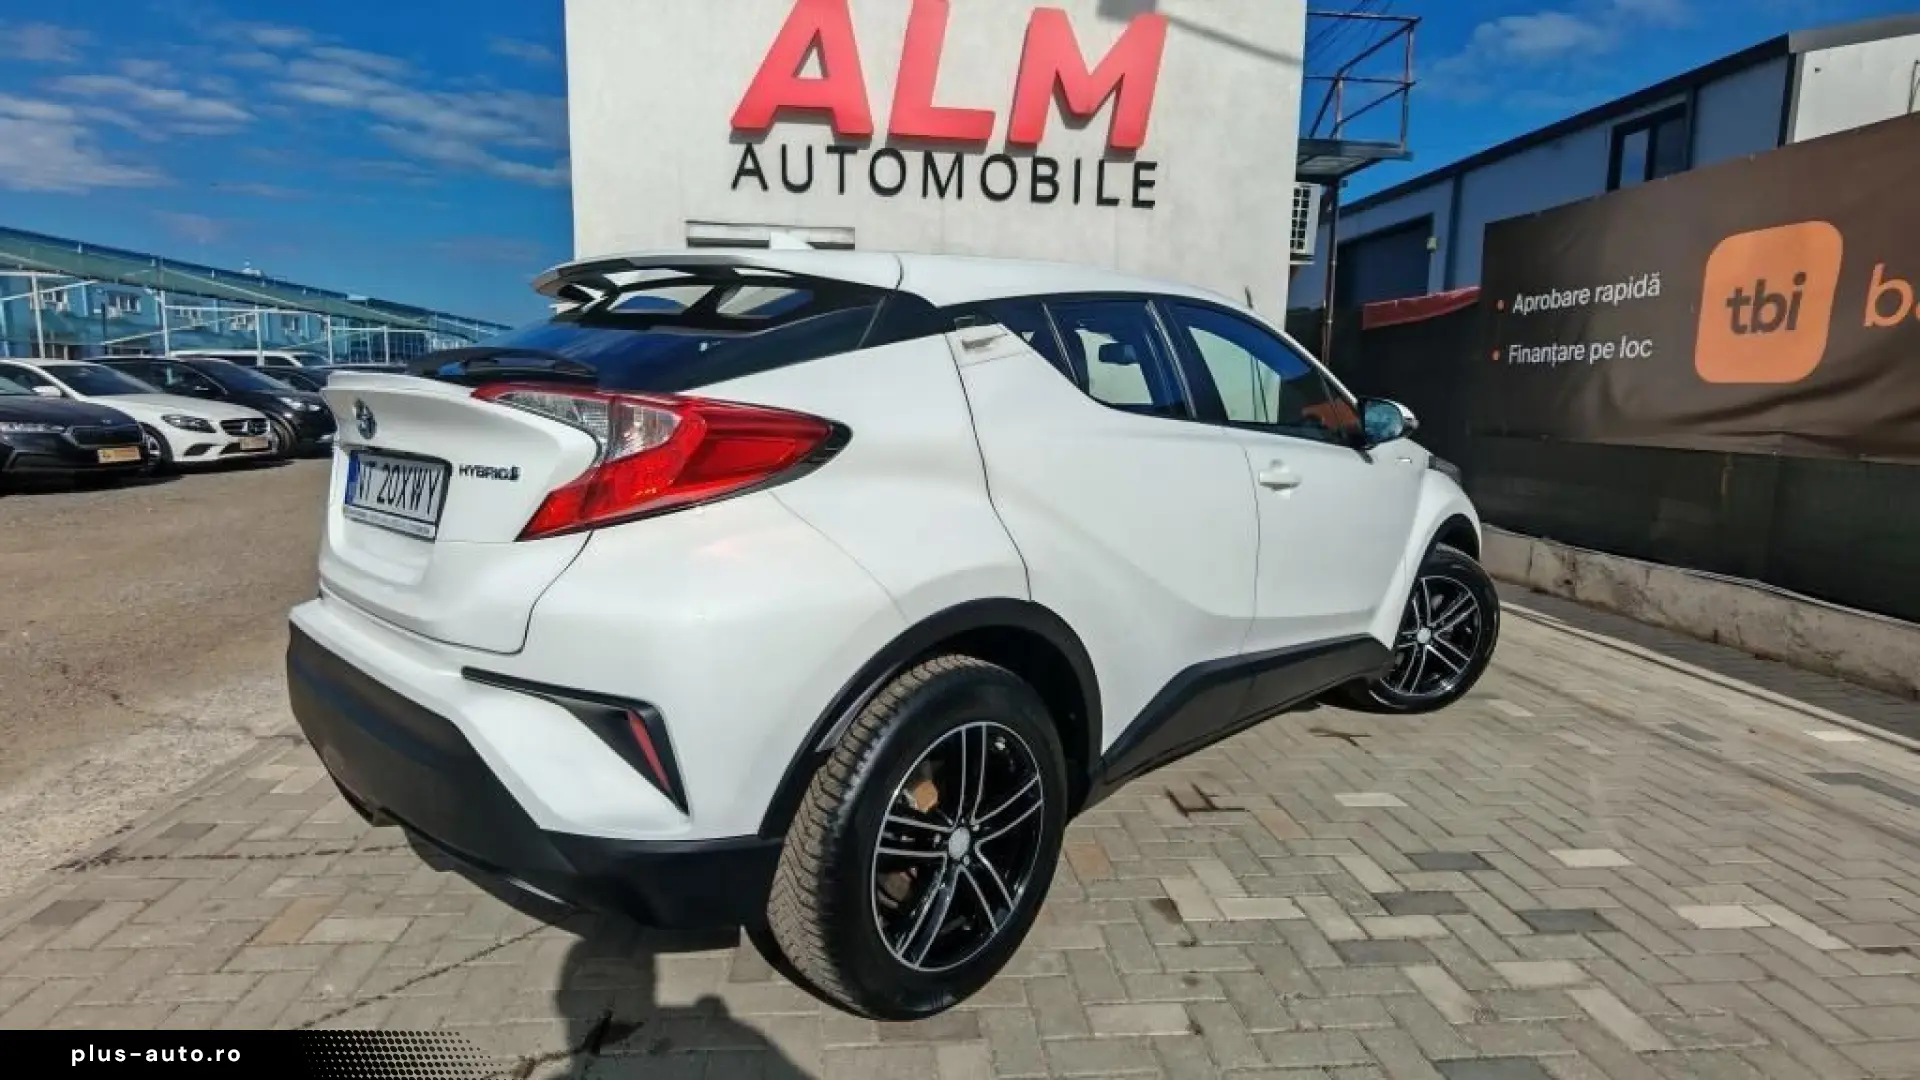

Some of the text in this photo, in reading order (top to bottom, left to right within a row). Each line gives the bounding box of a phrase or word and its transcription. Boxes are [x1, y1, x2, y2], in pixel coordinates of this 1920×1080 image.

[731, 0, 1168, 150] ALM
[731, 143, 1158, 208] AUTOMOBILE
[1512, 272, 1660, 316] Aprobare rapidă
[1726, 263, 1920, 335] tbi b
[1508, 336, 1653, 367] Finanțare pe loc
[377, 463, 442, 515] 20XWY
[459, 464, 510, 480] HYBRID
